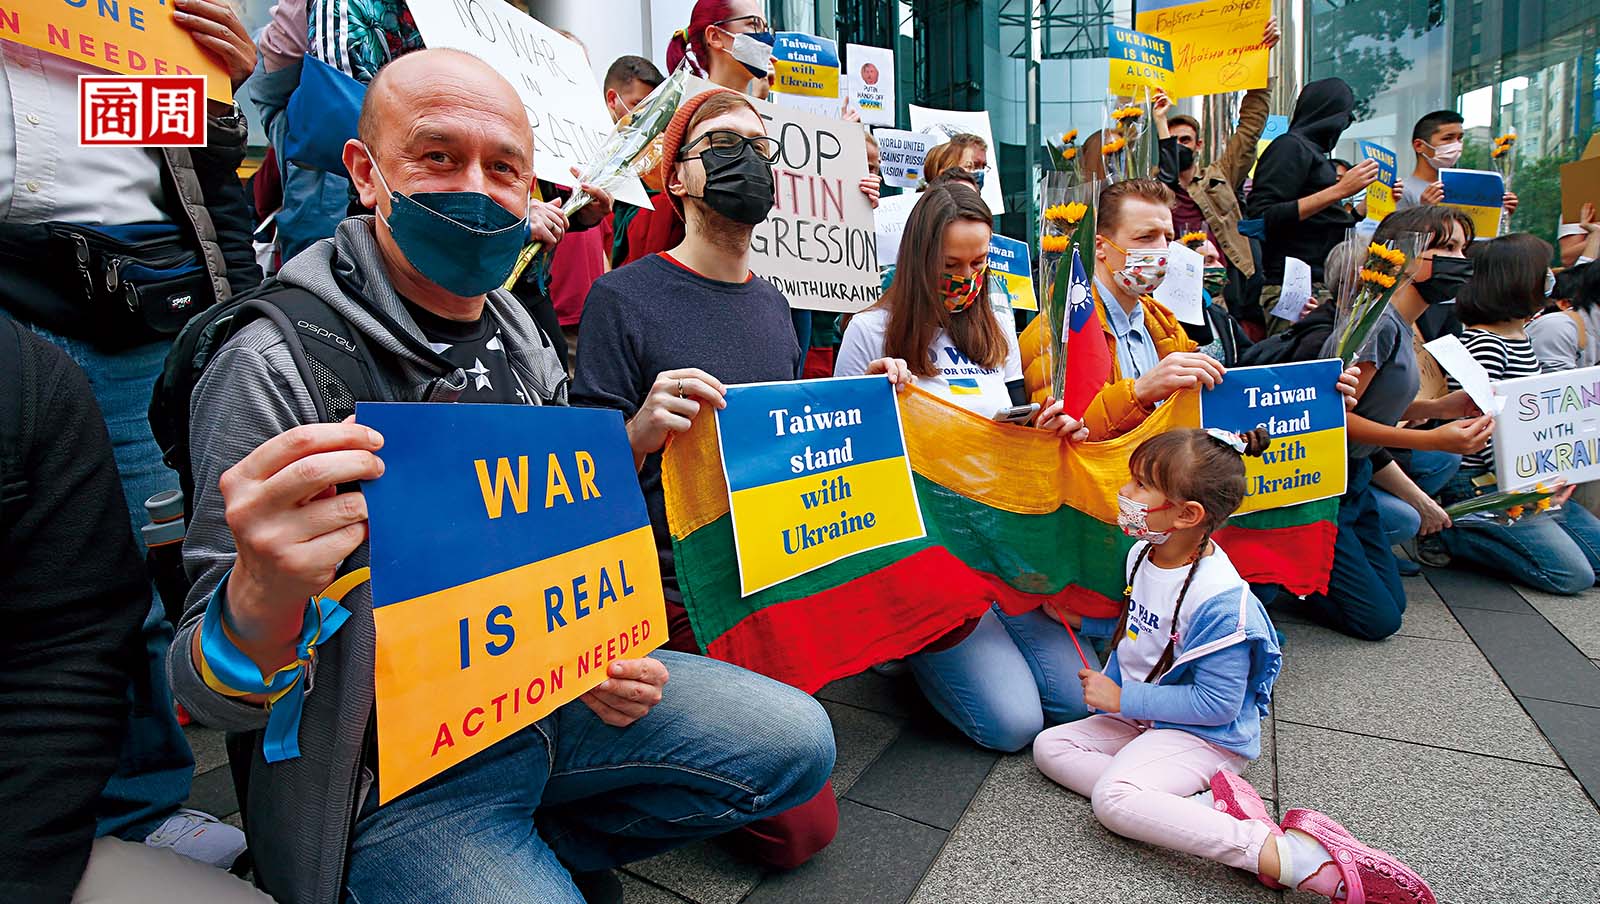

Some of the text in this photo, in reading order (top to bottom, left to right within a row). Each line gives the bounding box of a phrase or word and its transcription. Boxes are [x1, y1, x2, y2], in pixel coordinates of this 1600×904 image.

[493, 11, 577, 85] WAR
[780, 38, 822, 51] Taiwan
[1116, 31, 1165, 54] UKRAINE
[787, 51, 818, 63] stand
[1123, 47, 1163, 67] IS NOT
[791, 64, 815, 75] with
[1127, 65, 1166, 82] ALONE
[780, 75, 824, 89] Ukraine
[903, 141, 925, 152] UNITED
[987, 256, 1010, 273] tand
[298, 320, 356, 352] osprey
[1243, 384, 1317, 408] Taiwan
[769, 405, 862, 437] Taiwan
[1533, 422, 1574, 442] WITH
[790, 437, 854, 474] stand
[1261, 440, 1306, 465] with
[1516, 438, 1600, 479] UKRAI
[474, 450, 602, 520] WAR
[800, 475, 852, 510] with
[781, 511, 876, 556] Ukraine
[459, 559, 635, 670] IS REAL
[431, 618, 651, 757] ACTION NEEDED
